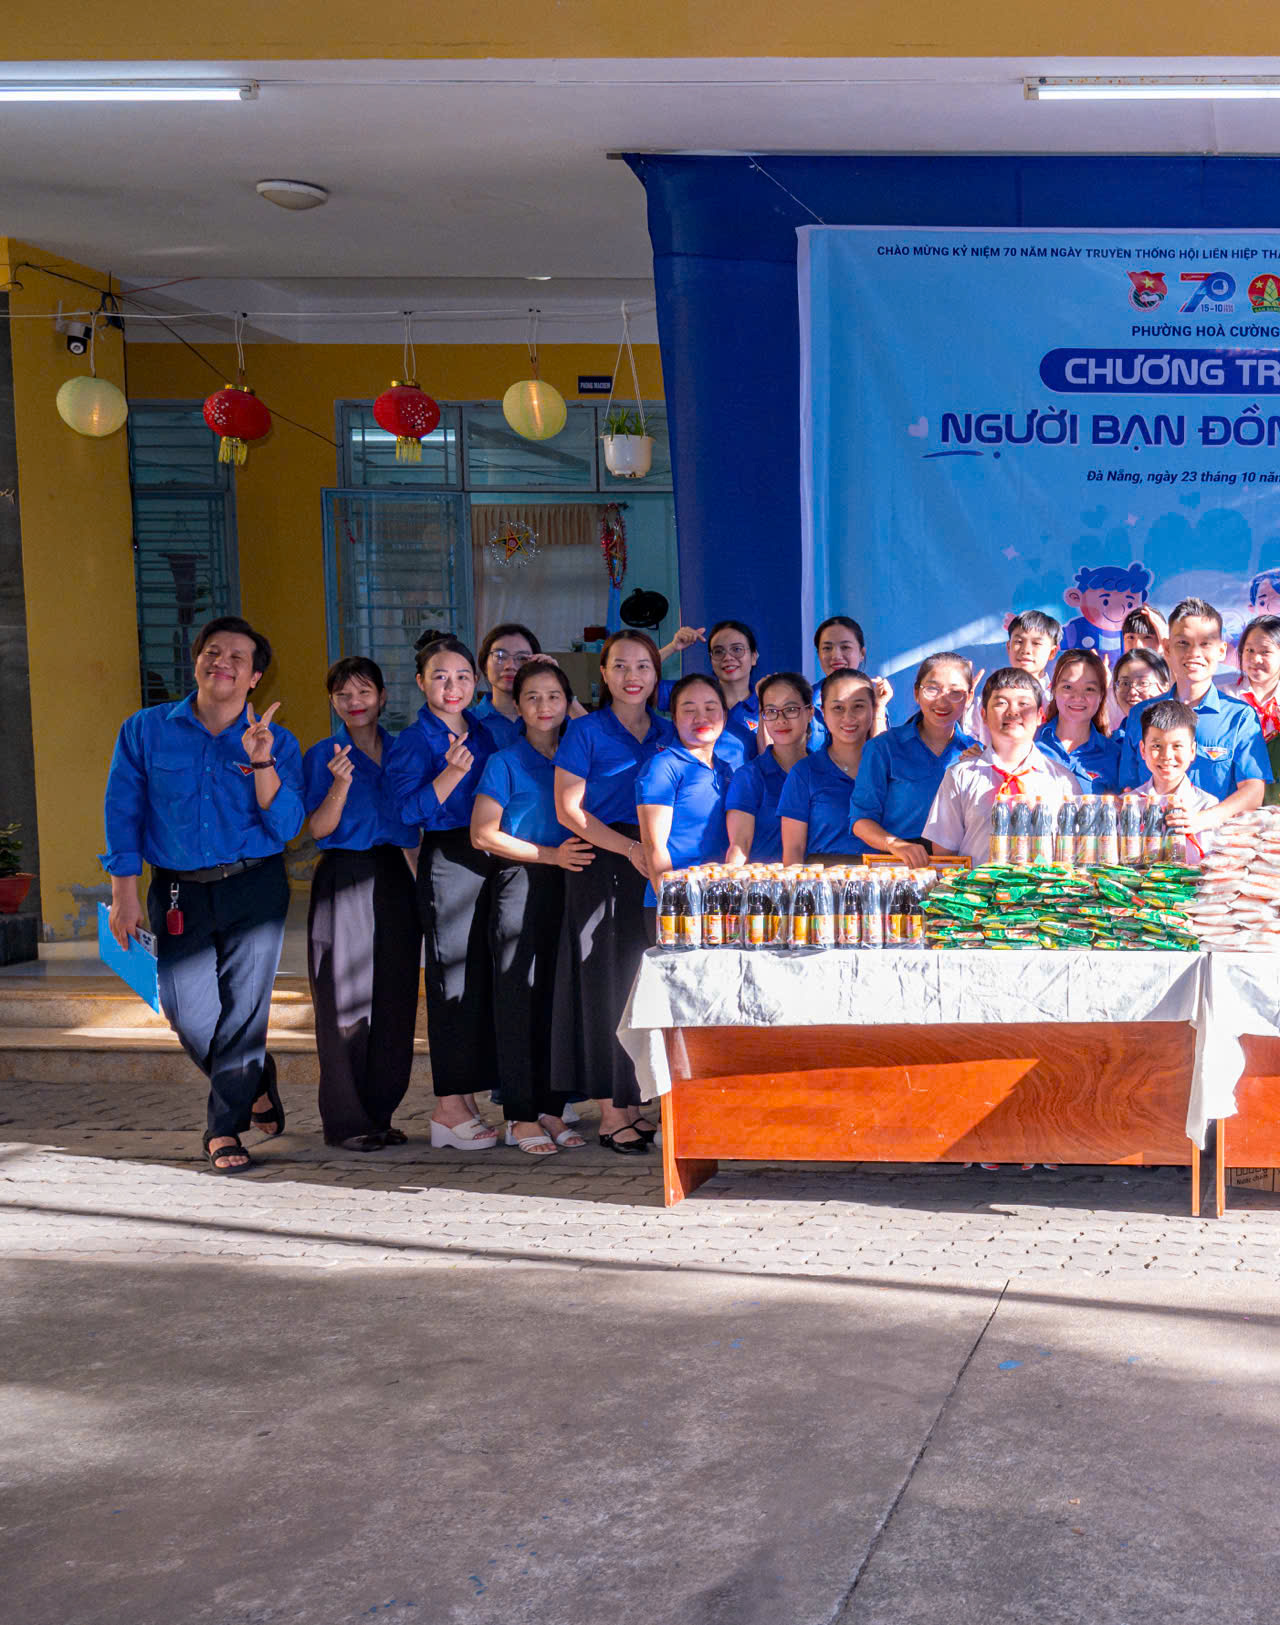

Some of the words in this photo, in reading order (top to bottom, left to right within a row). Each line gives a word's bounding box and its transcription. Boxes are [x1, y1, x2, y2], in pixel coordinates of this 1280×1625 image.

[877, 243, 909, 256] CHÀO
[913, 243, 950, 257] MỪNG
[953, 244, 968, 257] KỶ
[970, 246, 1000, 259] NIỆM
[1003, 247, 1017, 257] 70
[1020, 246, 1047, 257] NĂM
[1050, 246, 1081, 258] NGÀY
[1086, 246, 1131, 259] TRUYỀN
[1135, 246, 1175, 259] THỐNG
[1179, 248, 1199, 261] HỘI
[1203, 247, 1228, 260] LIÊN
[1231, 247, 1258, 261] HIỆP
[1131, 322, 1192, 337] PHƯỜNG
[1196, 323, 1226, 337] HOÀ
[1229, 323, 1280, 338] CƯỜNG
[1065, 354, 1225, 386] CHƯƠNG
[941, 405, 1078, 445] NGƯỜI
[1091, 414, 1185, 451] BẠN
[1086, 470, 1104, 482] Đà
[1107, 469, 1143, 484] Nẵng,
[1147, 471, 1178, 484] ngày
[1181, 472, 1197, 483] 23
[1201, 471, 1237, 485] tháng
[1241, 472, 1255, 483] 10
